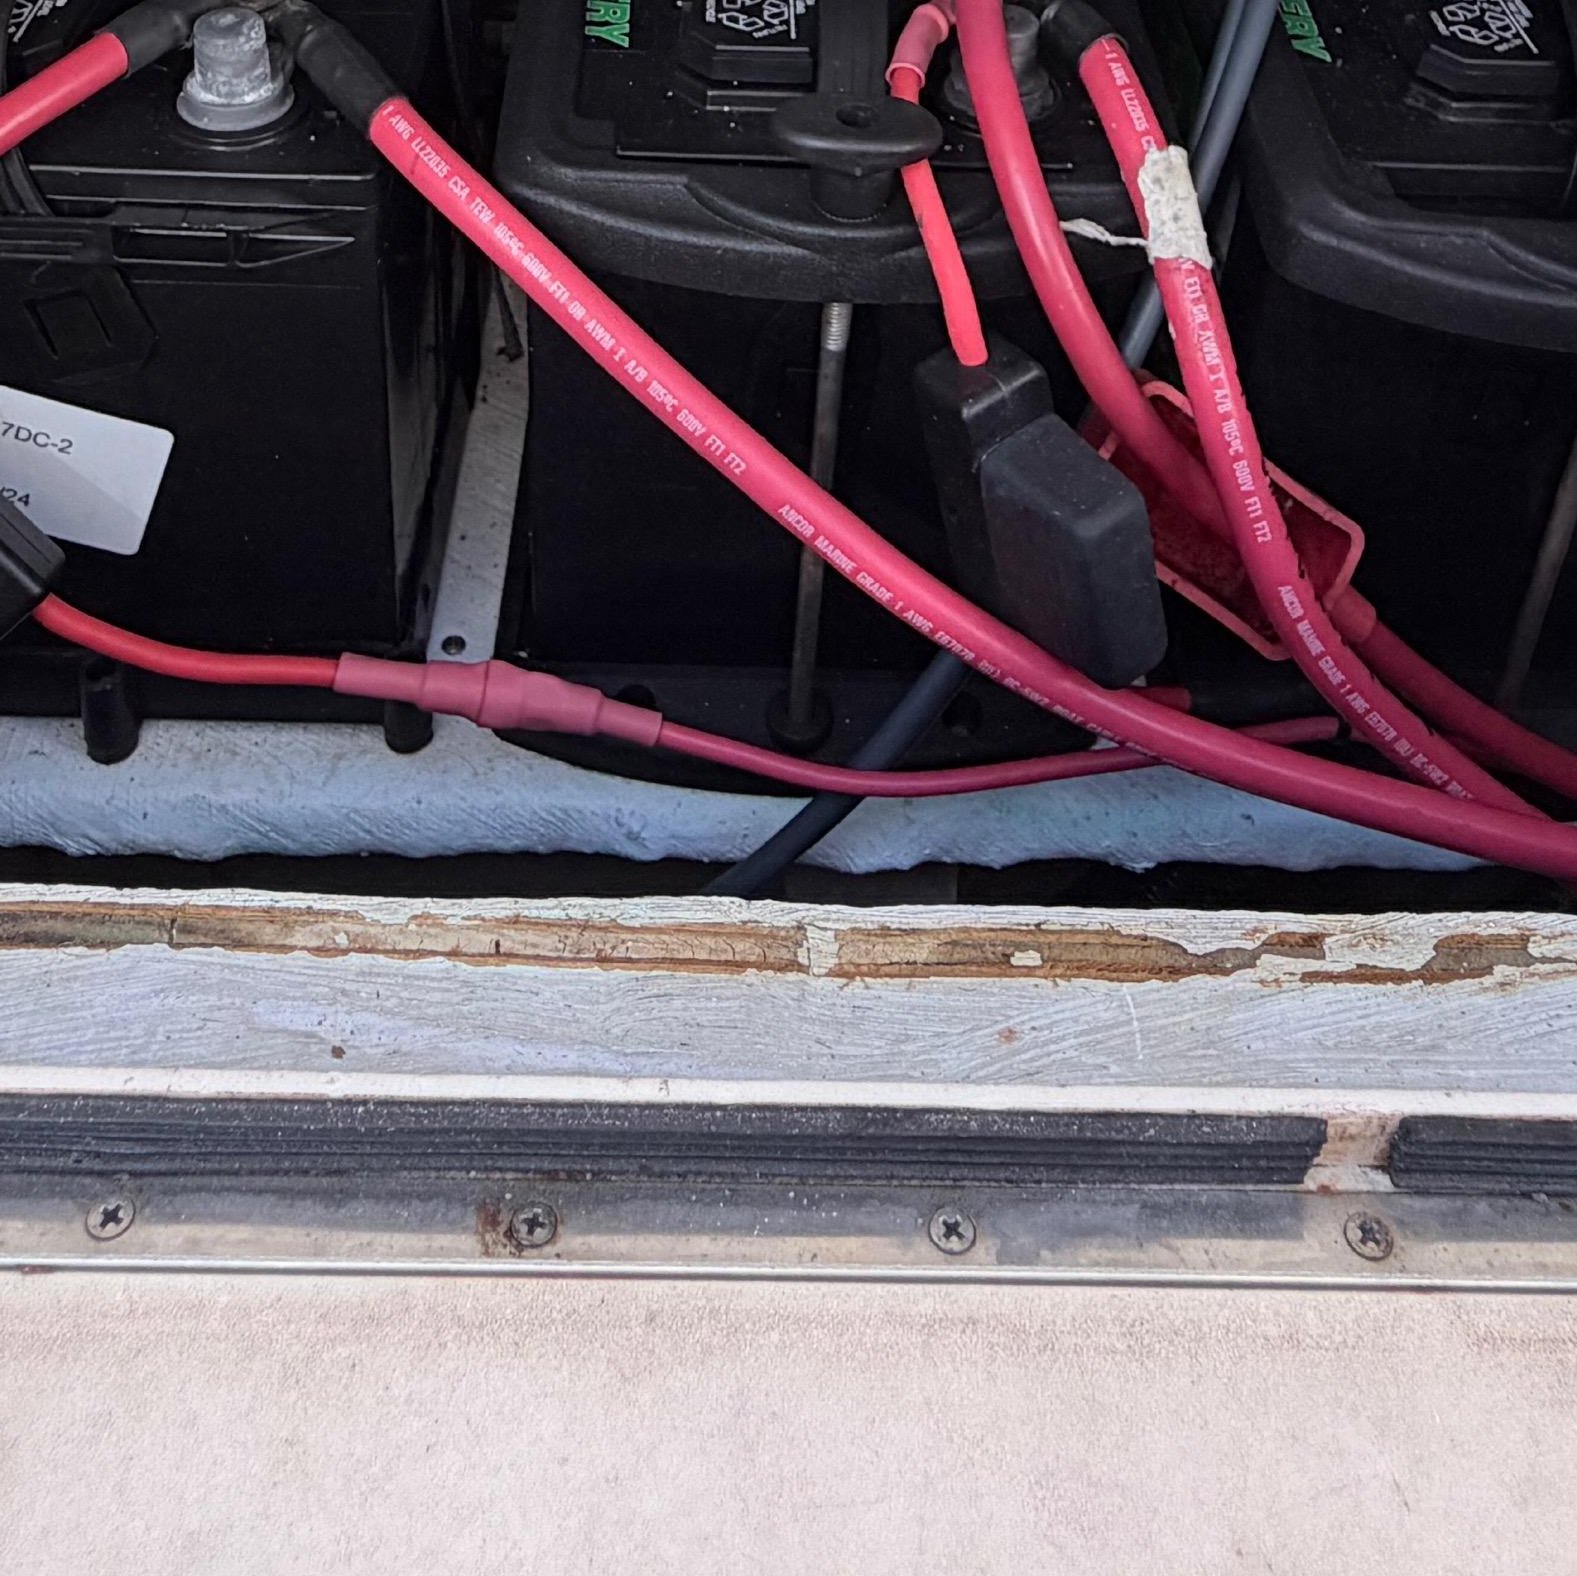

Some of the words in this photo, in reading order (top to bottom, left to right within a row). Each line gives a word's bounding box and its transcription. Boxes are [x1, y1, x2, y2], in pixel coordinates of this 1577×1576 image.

[389, 114, 414, 140] AWG
[448, 176, 470, 200] CSA
[470, 196, 495, 221] TEW
[625, 360, 648, 382] A/B
[724, 453, 746, 475] FT2
[1232, 460, 1255, 491] 600V
[1244, 496, 1263, 518] FT1
[1253, 521, 1272, 543] FT2
[856, 572, 893, 603] GRADE
